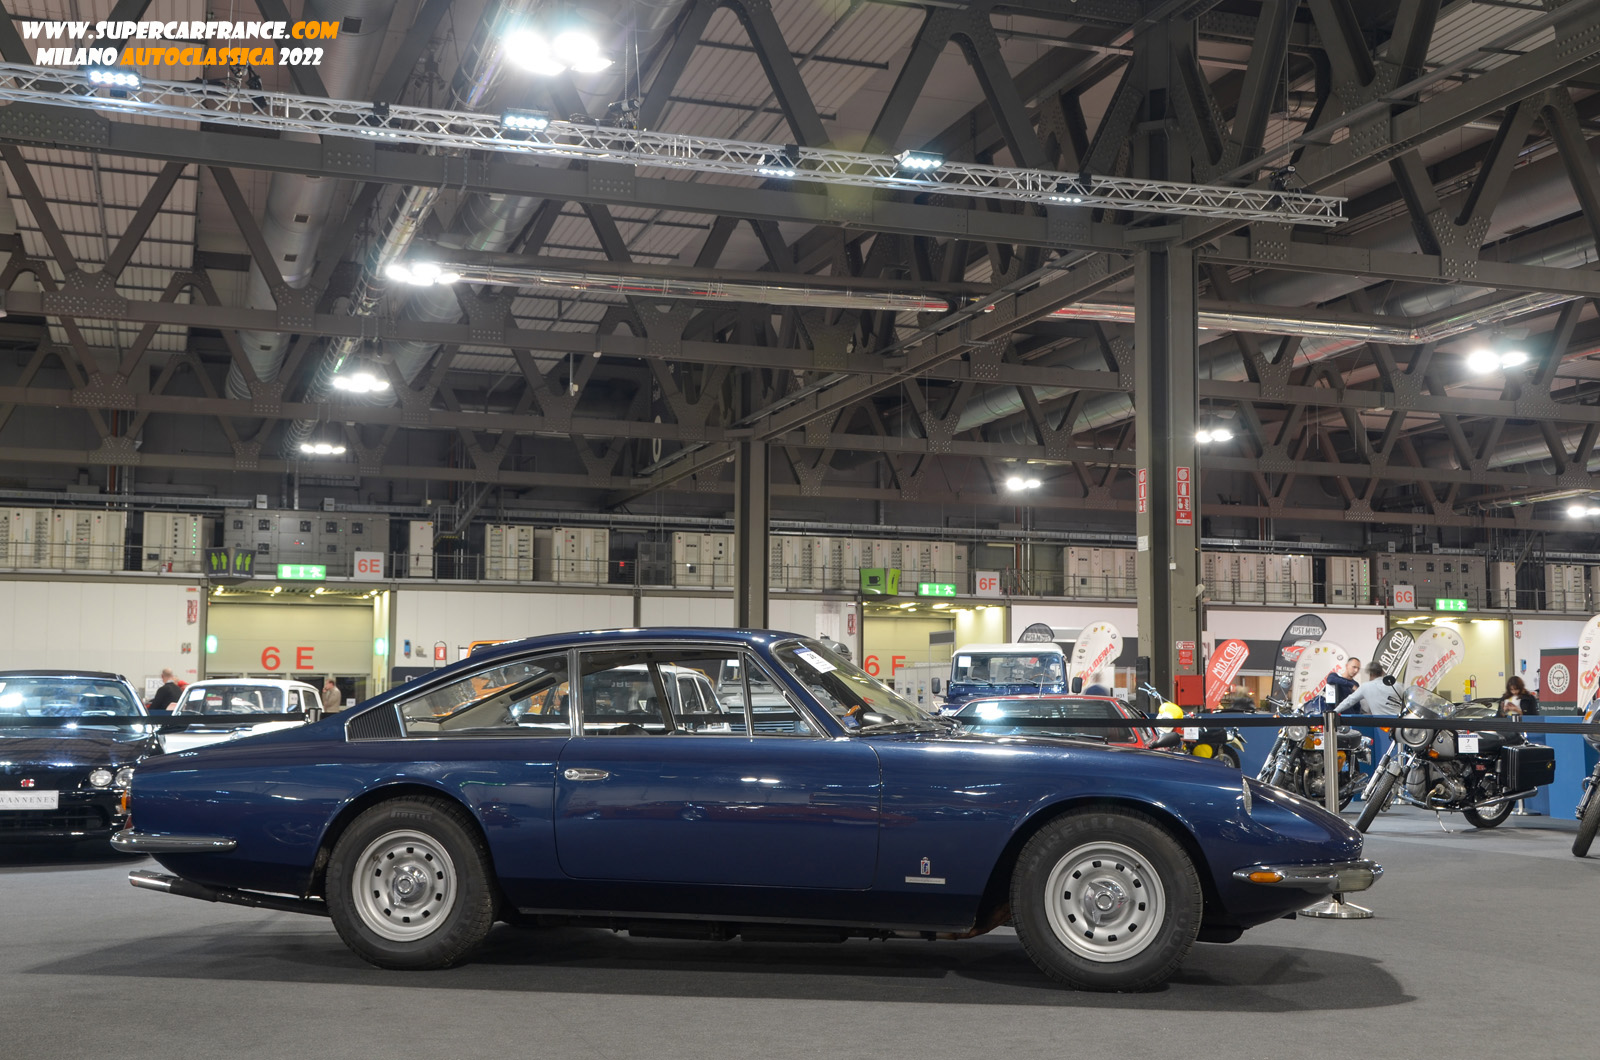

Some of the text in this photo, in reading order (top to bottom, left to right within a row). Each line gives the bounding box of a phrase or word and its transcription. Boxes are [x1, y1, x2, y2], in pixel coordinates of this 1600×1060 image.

[358, 559, 381, 573] 6E
[979, 577, 997, 591] 6F
[1395, 590, 1413, 603] 6G
[1389, 630, 1408, 652] CAR
[261, 646, 315, 671] 6 E
[864, 654, 906, 677] 6 F
[1211, 657, 1231, 679] MAX
[1223, 641, 1242, 661] CAR
[1415, 649, 1457, 688] SCUDERIA
